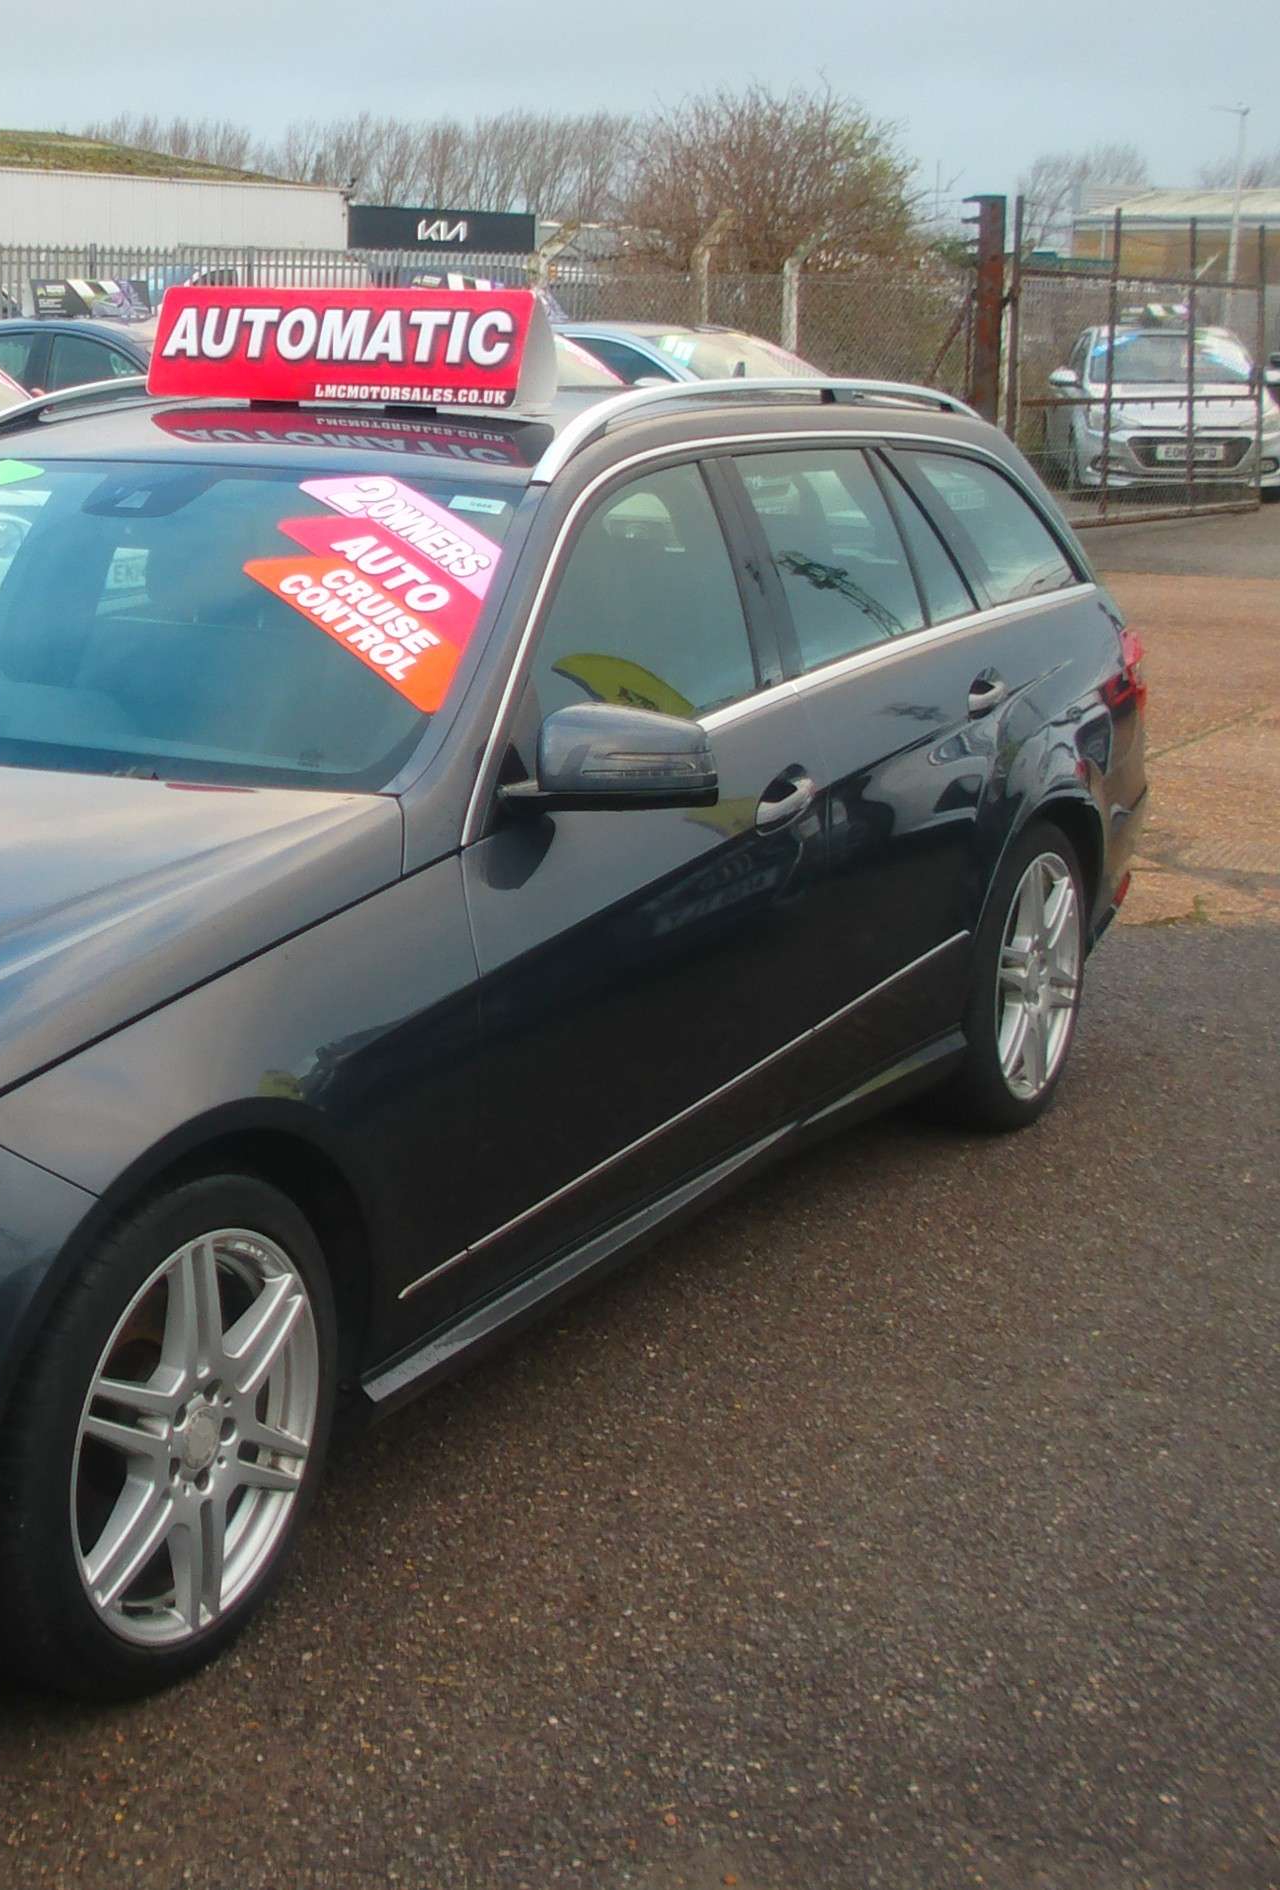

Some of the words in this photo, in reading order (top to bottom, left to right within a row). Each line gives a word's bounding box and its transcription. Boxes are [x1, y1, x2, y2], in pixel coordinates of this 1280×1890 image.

[417, 219, 467, 242] KIA
[161, 307, 513, 366] AUTOMATIC
[313, 384, 507, 405] LMCMOTORSALES.CO.UK
[326, 479, 398, 513] 2
[366, 499, 492, 577] OWNERS
[321, 568, 441, 655] CRUISE
[329, 535, 451, 612] AUTO
[278, 573, 417, 681] CONTROL
